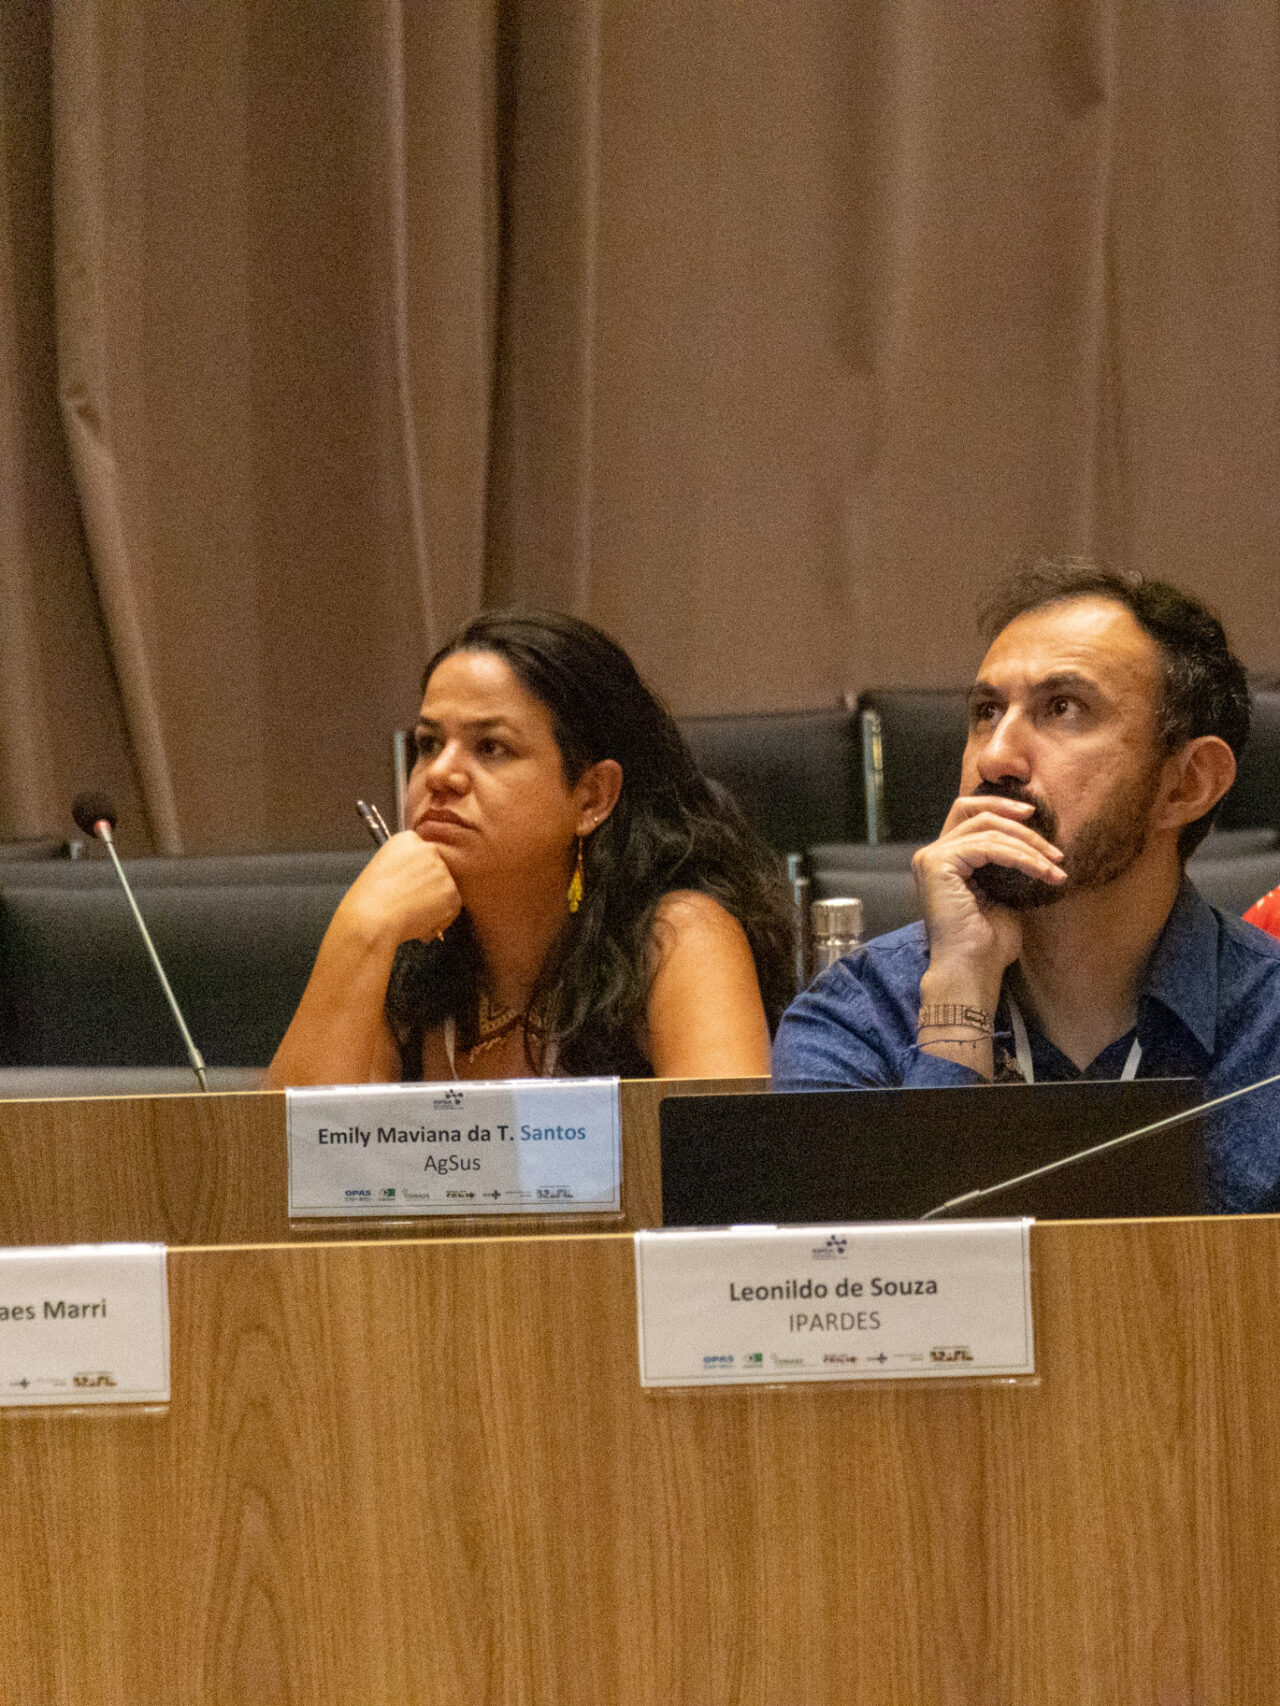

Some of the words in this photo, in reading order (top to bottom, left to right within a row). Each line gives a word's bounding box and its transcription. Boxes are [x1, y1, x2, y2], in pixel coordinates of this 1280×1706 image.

[318, 1126, 371, 1148] Emily
[377, 1125, 462, 1143] Maviana
[467, 1124, 491, 1142] da
[496, 1125, 514, 1142] T.
[520, 1124, 586, 1141] Santos
[423, 1154, 481, 1176] AgSus
[345, 1189, 372, 1197] OPAS
[729, 1280, 828, 1302] Leonildo
[835, 1278, 863, 1298] de
[870, 1277, 938, 1297] Souza
[0, 1305, 36, 1321] aes
[43, 1299, 107, 1320] Marri
[789, 1311, 881, 1332] IPARDES
